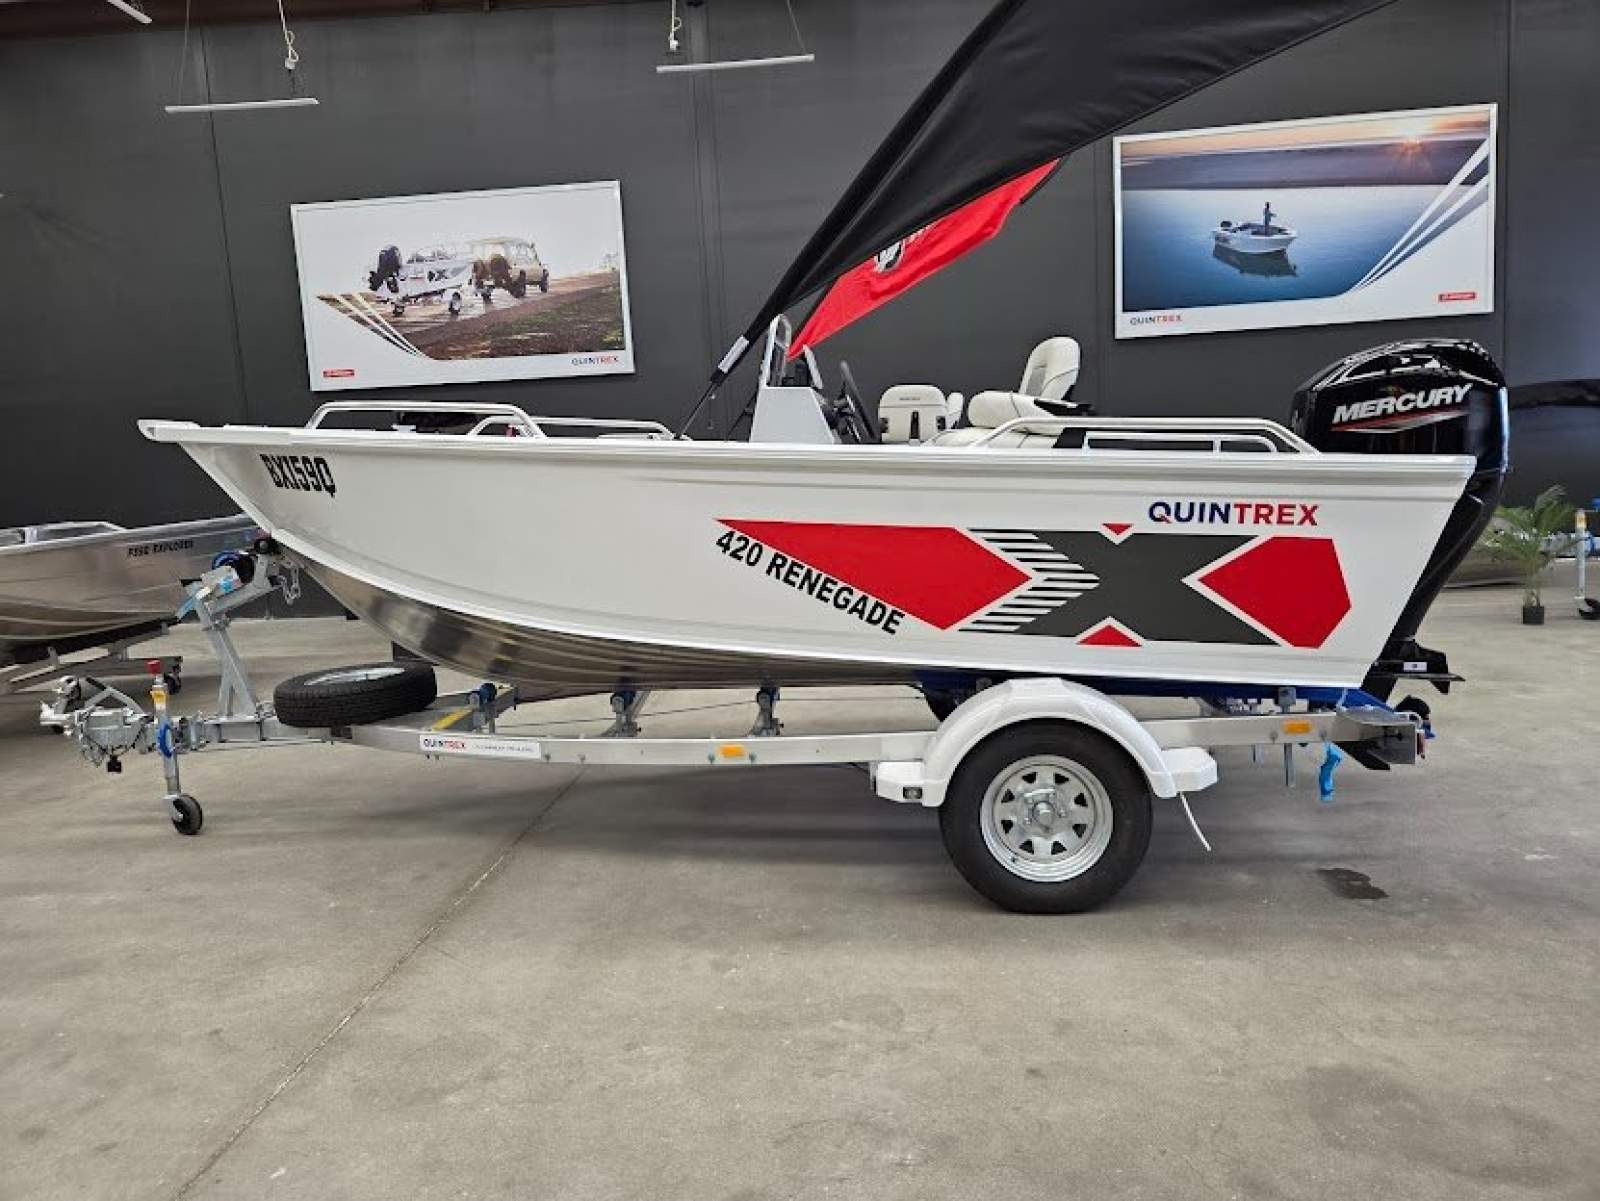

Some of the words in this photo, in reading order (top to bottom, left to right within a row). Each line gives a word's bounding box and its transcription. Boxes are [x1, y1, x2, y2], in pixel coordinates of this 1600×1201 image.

[1130, 314, 1182, 326] QUINTREX
[571, 355, 619, 366] QUINTREX
[1332, 383, 1473, 424] MERCURY
[1149, 501, 1318, 526] QUINTREX
[715, 530, 764, 567] 420
[765, 551, 906, 635] RENEGADE
